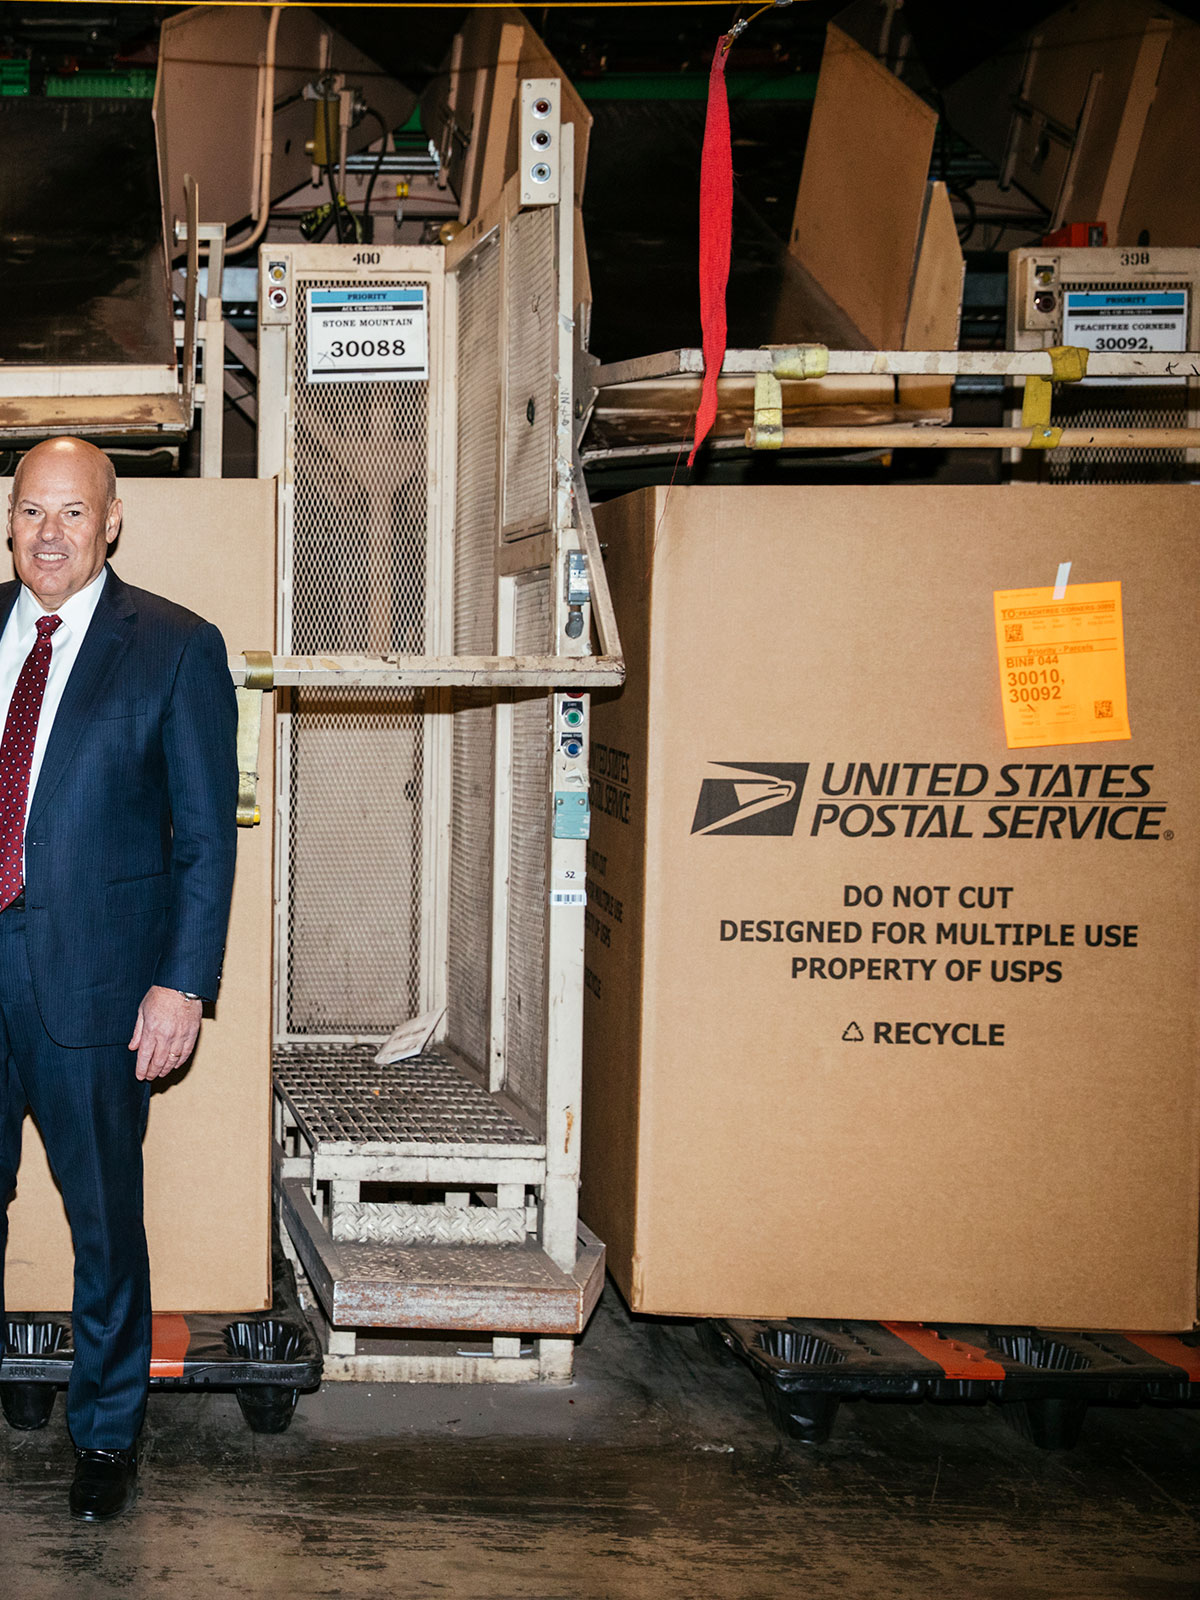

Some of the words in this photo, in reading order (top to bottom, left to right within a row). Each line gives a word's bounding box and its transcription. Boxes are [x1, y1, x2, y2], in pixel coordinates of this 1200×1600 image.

[352, 253, 381, 265] 400
[1120, 252, 1150, 266] 398
[322, 319, 357, 328] STONE
[359, 318, 413, 327] MOUNTAIN
[1074, 323, 1129, 331] PEACHTREE
[1132, 323, 1177, 331] CORNERS
[330, 339, 406, 358] 30088
[1027, 648, 1057, 656] Priority
[1006, 657, 1034, 669] BIN#
[1037, 655, 1059, 666] 044
[1007, 668, 1065, 687] 30010,
[1009, 685, 1062, 703] 30092
[821, 763, 989, 797] UNITED
[995, 764, 1155, 798] STATES
[810, 804, 973, 838] POSTAL
[843, 885, 883, 908] DO
[893, 885, 950, 909] NOT
[958, 886, 1014, 909] CUT
[719, 920, 862, 944] DESIGNED
[871, 922, 927, 945] FOR
[935, 923, 1075, 947] MULTIPLE
[1084, 924, 1139, 948] USE
[791, 957, 937, 981] PROPERTY
[945, 958, 982, 982] OF
[990, 959, 1063, 983] USPS
[873, 1022, 1005, 1046] RECYCLE
[8, 1366, 46, 1377] SERVICE
